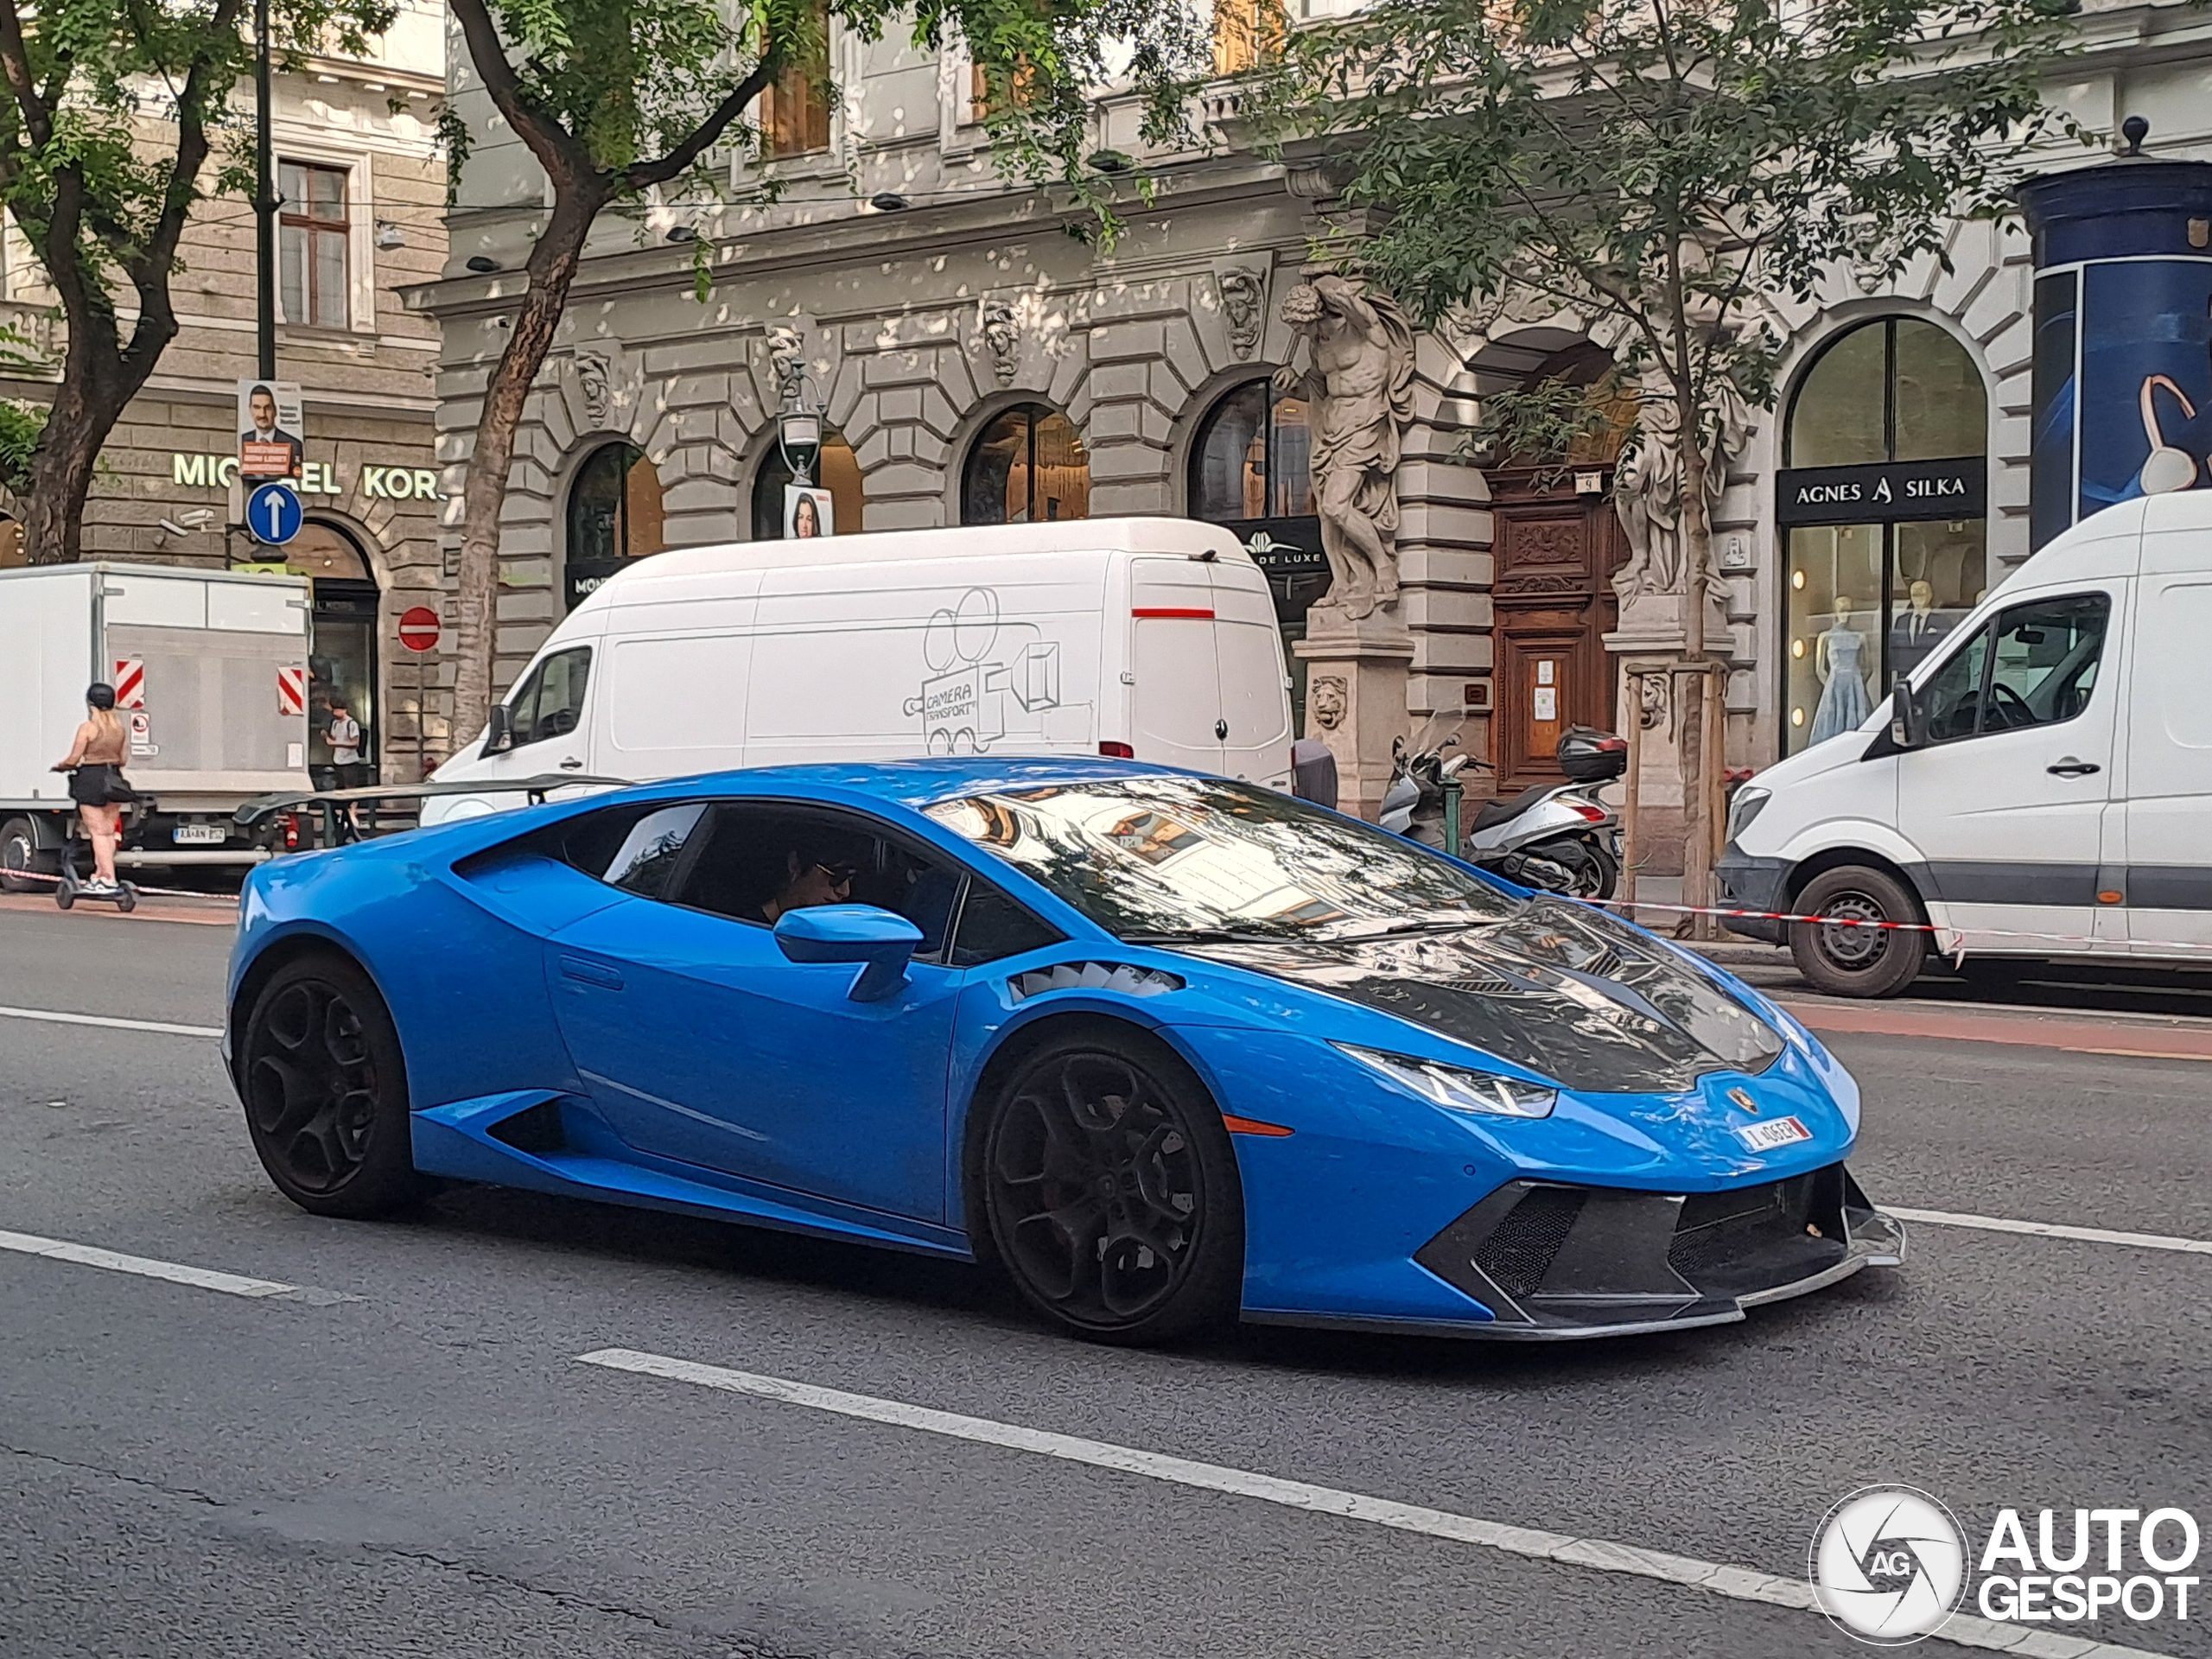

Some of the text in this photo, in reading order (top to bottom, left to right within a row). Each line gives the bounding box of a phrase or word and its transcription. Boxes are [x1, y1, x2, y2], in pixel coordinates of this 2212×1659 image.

[363, 467, 448, 500] KOR
[1796, 484, 1860, 504] AGNES
[1905, 477, 1965, 498] SILKA
[1259, 554, 1320, 564] DE LUXE
[927, 683, 972, 709] CAMERA
